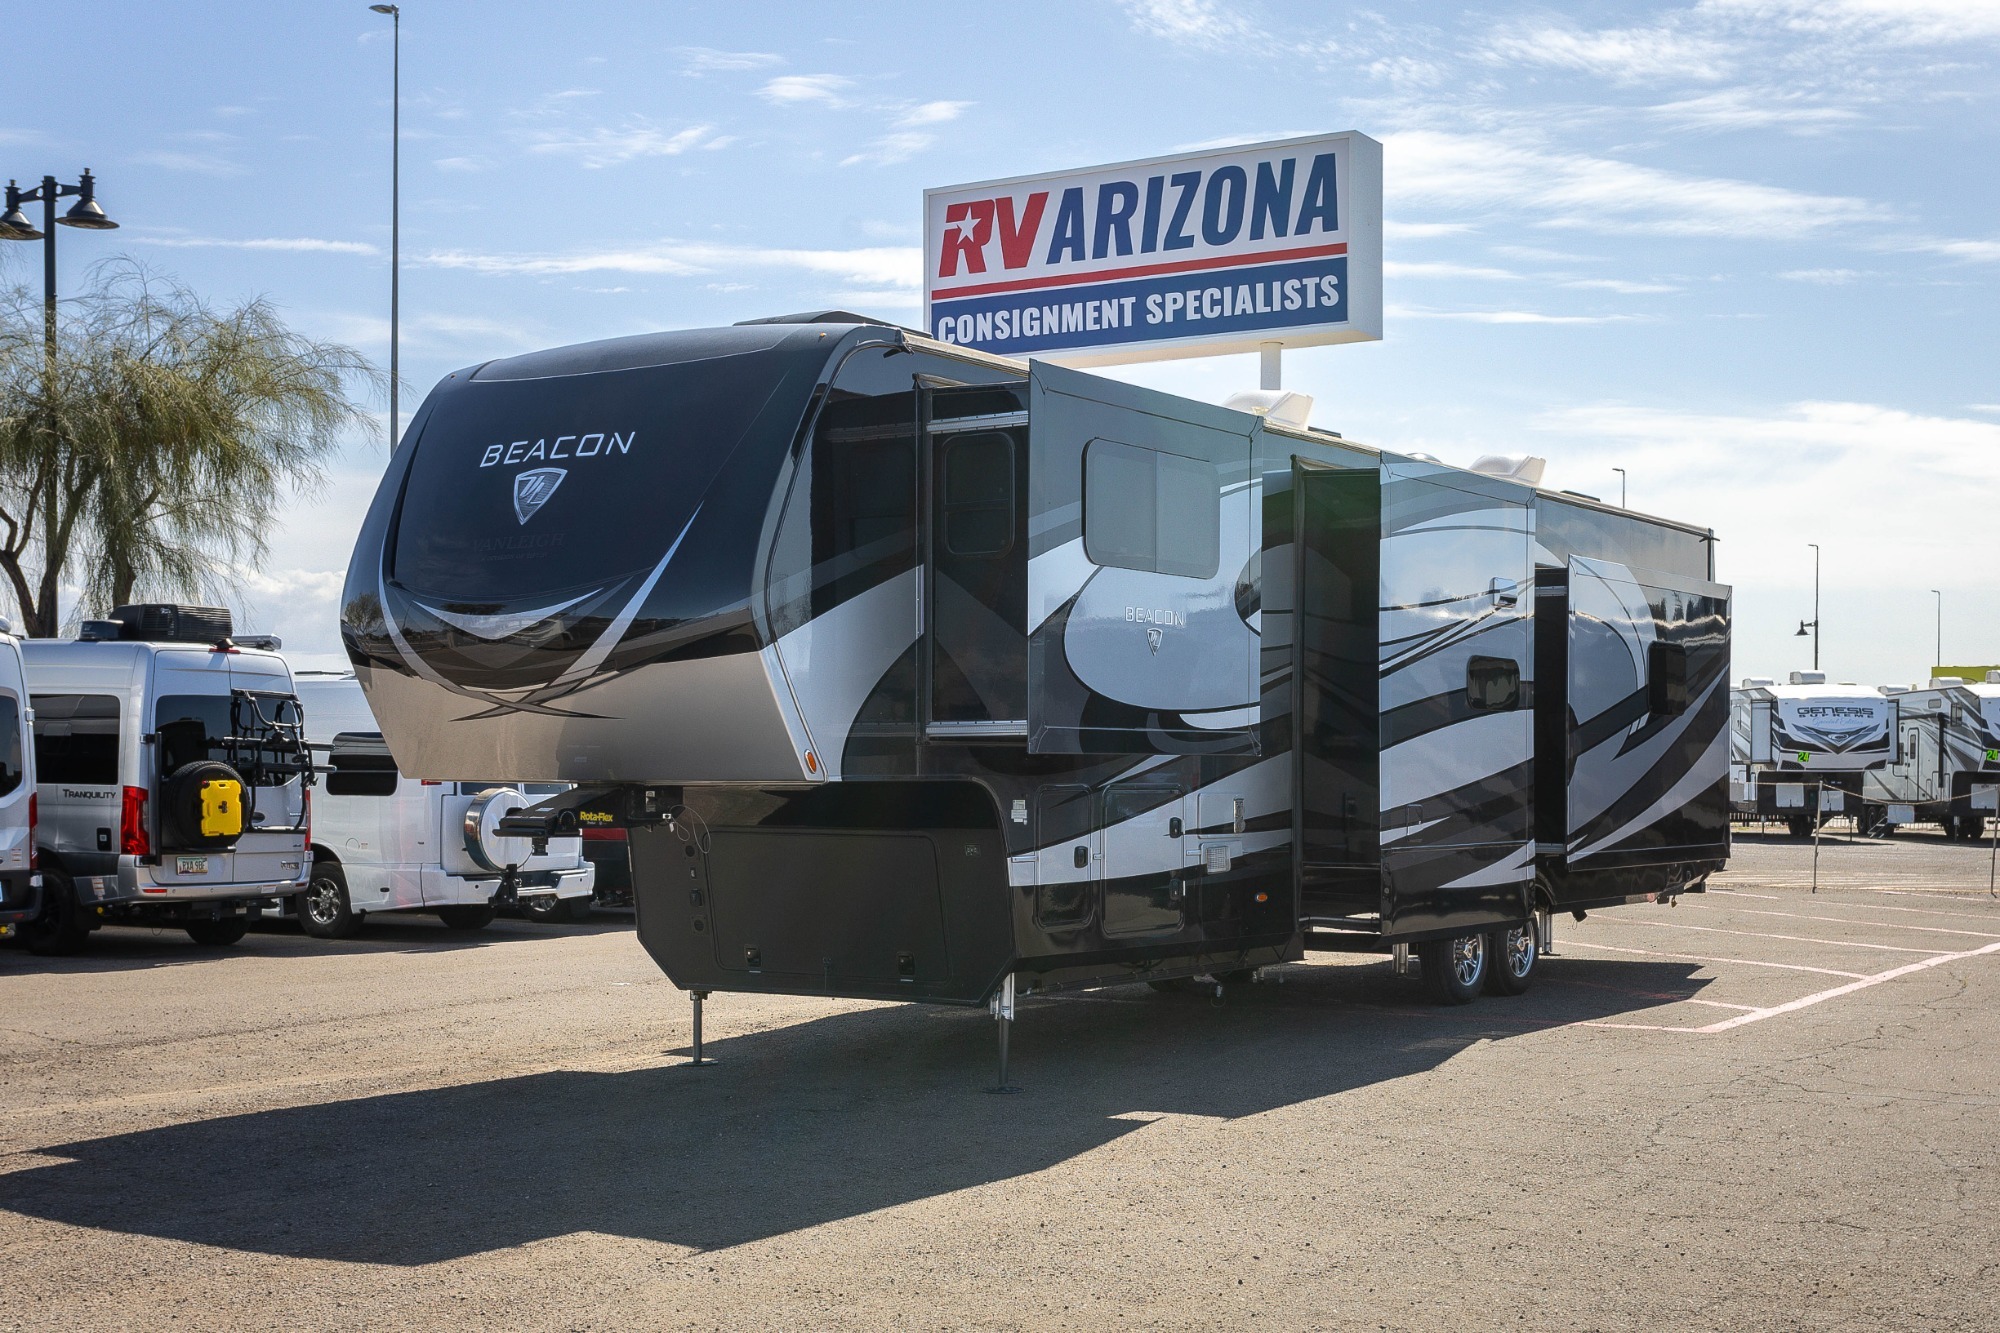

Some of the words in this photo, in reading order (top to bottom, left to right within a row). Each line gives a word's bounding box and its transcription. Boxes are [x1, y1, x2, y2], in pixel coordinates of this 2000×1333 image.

[938, 191, 1050, 278] RV
[1045, 152, 1340, 265] ARIZONA
[938, 297, 1137, 346] CONSIGNMENT
[1146, 274, 1340, 325] SPECIALISTS
[480, 431, 635, 467] BEACON
[472, 532, 566, 553] VANLEIGH
[1125, 606, 1184, 626] BEACON
[1797, 706, 1874, 715] GENESIS
[1797, 752, 1810, 762] 24
[1987, 750, 1998, 760] 24
